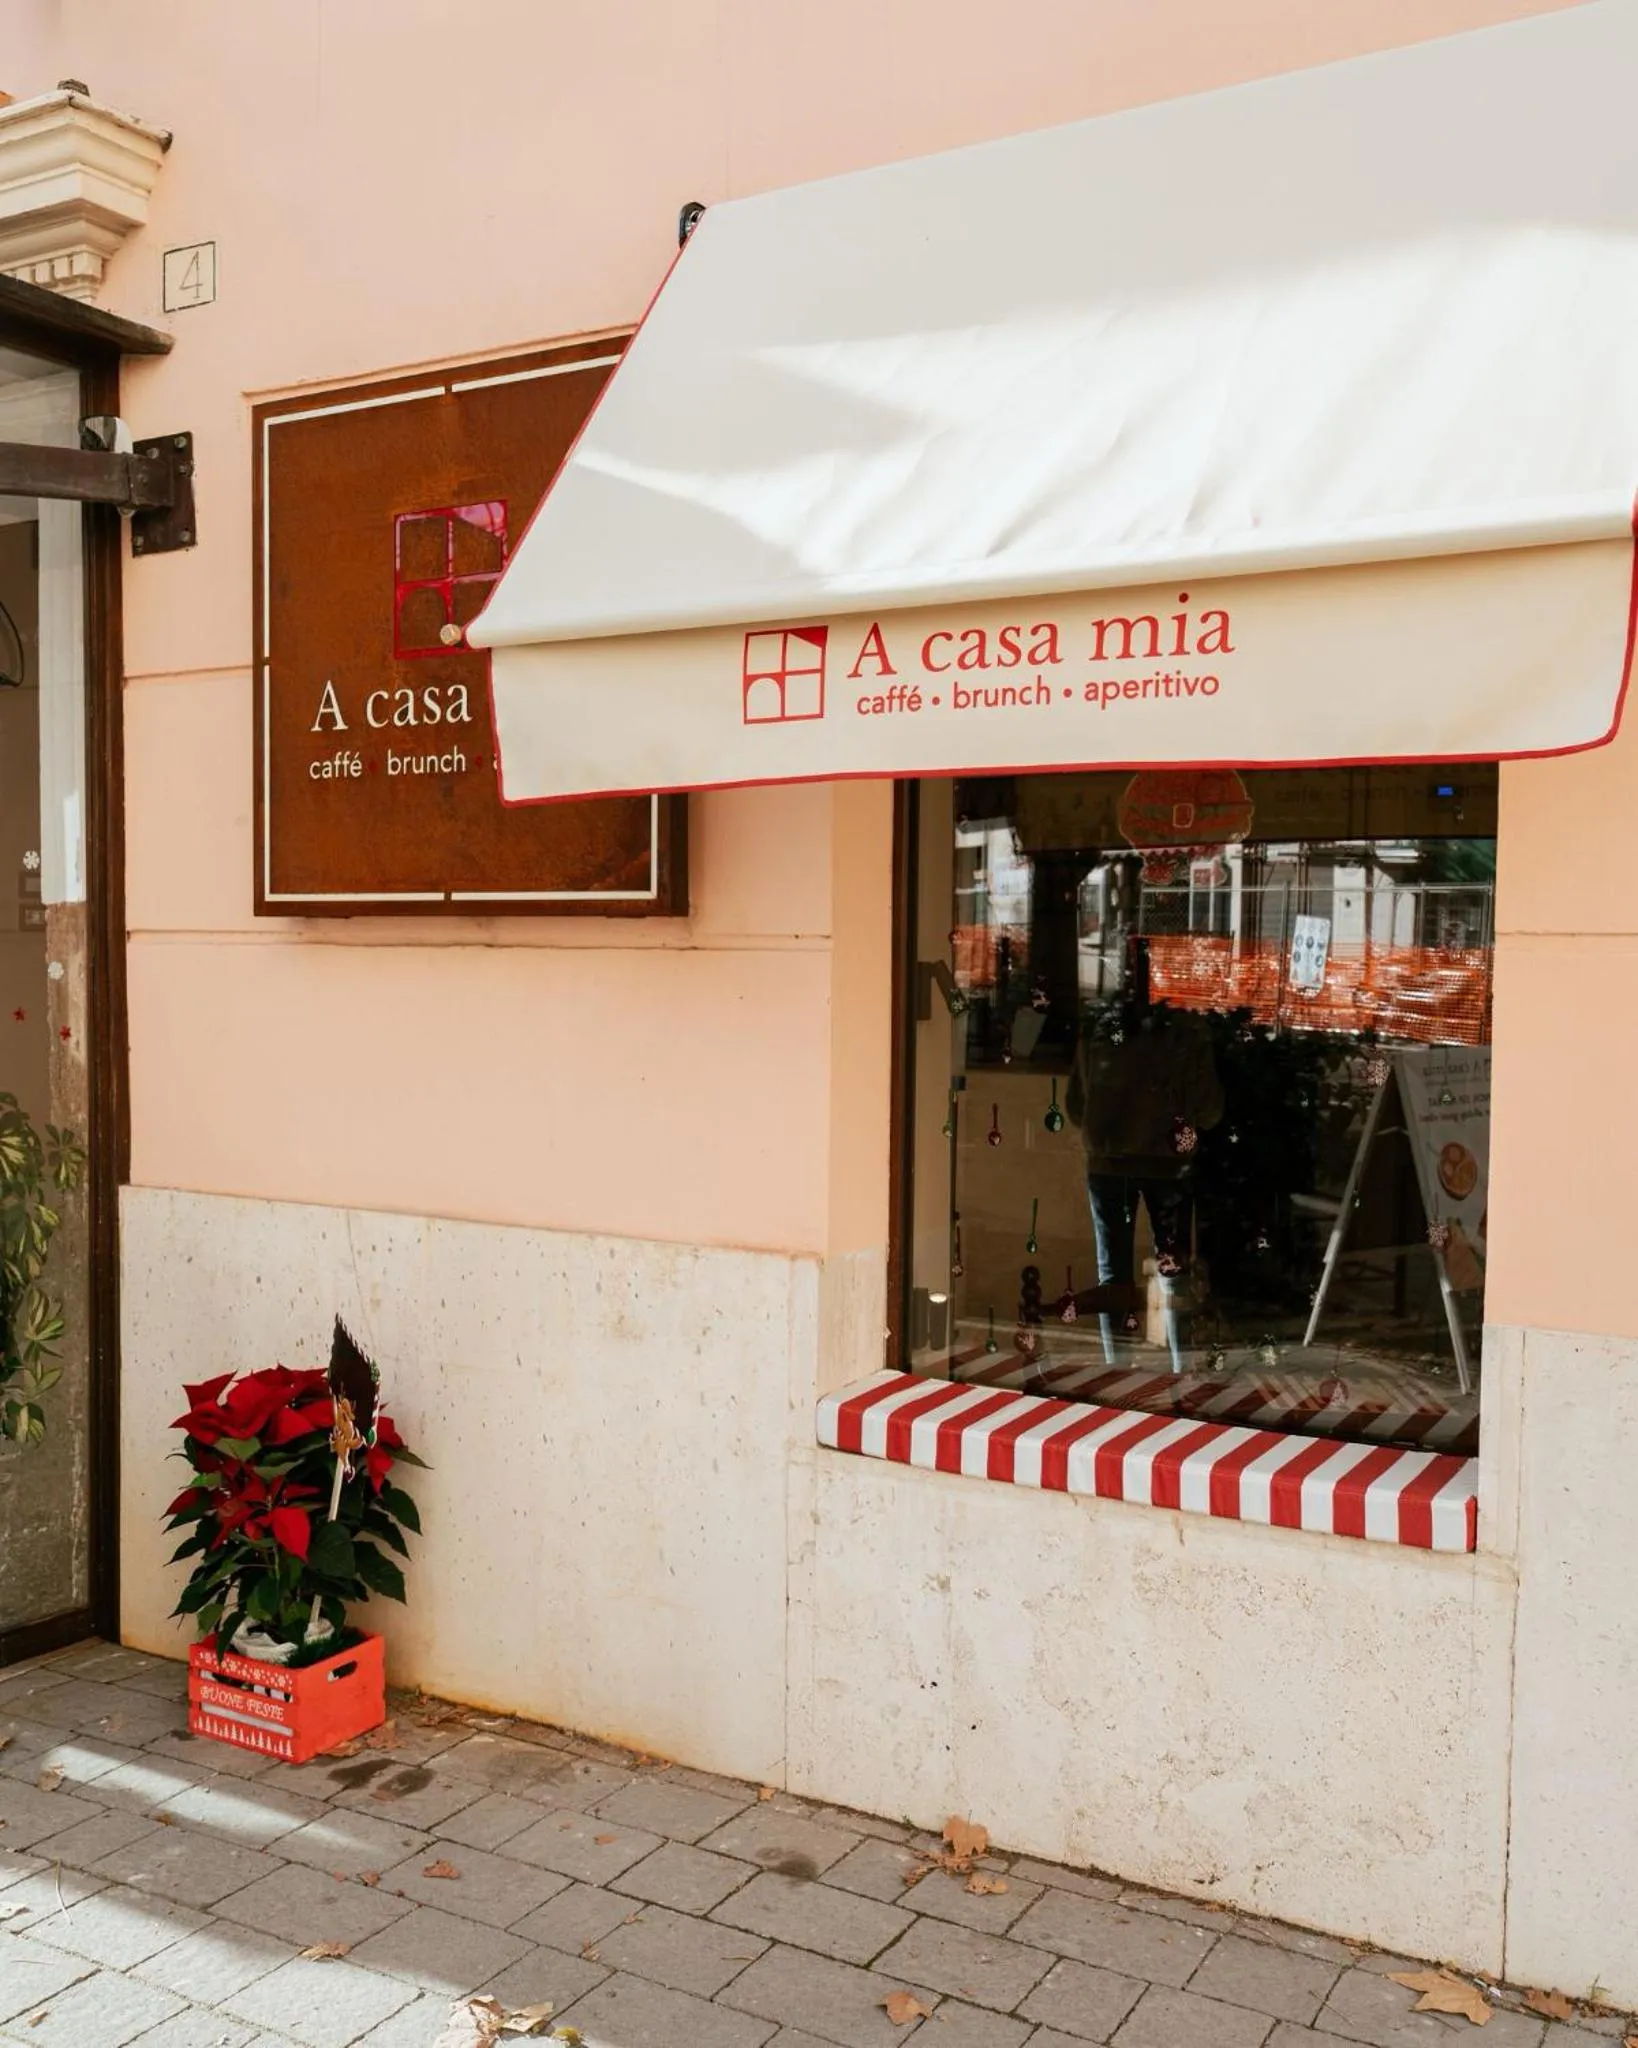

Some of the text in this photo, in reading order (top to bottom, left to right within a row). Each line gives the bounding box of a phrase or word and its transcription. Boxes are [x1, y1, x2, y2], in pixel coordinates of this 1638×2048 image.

[179, 250, 203, 299] 4
[847, 592, 1235, 678] A casa mia
[310, 680, 472, 732] A casa
[856, 669, 1220, 716] caffé brunch aperitivo
[309, 751, 362, 780] caffé
[387, 745, 466, 776] brunch
[200, 1686, 284, 1721] BUONE FESTE
